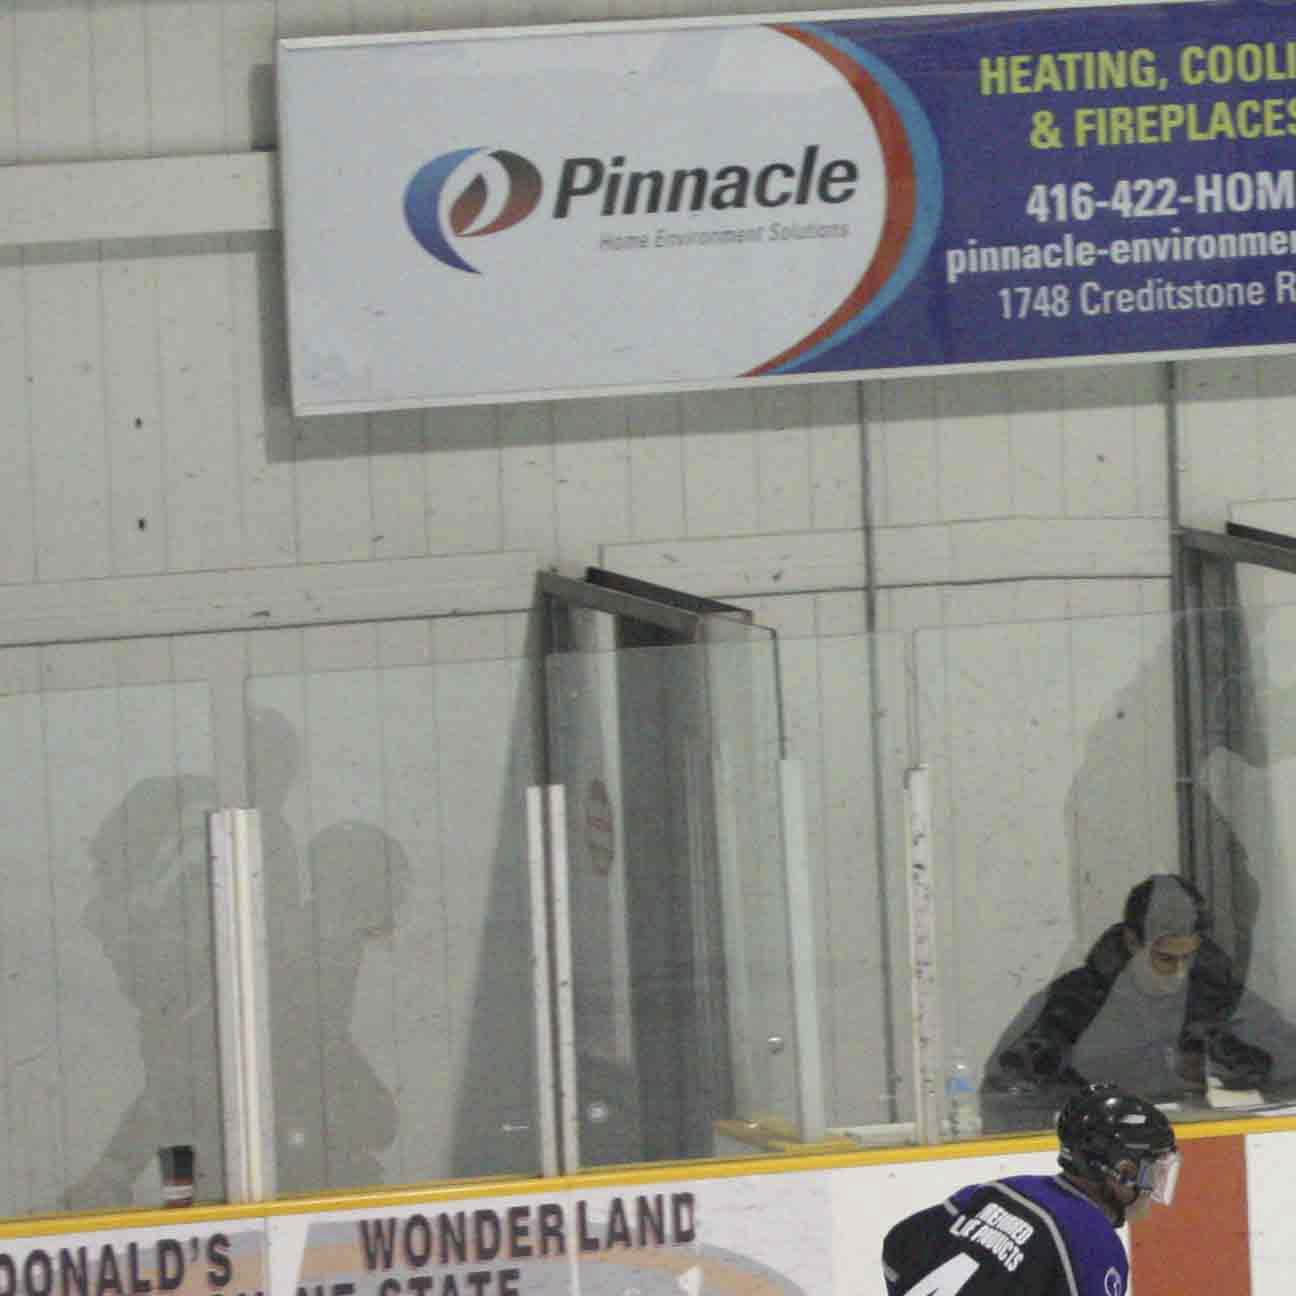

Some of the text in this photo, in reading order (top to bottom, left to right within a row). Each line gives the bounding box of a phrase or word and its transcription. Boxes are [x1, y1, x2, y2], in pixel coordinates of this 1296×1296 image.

[979, 48, 1169, 95] HEATING,
[1029, 109, 1062, 149] &
[552, 146, 859, 219] Pinnacle
[601, 221, 849, 250] Home Environment Solutions
[998, 286, 1071, 320] 1748
[1080, 275, 1267, 316] Creditstone
[359, 1192, 697, 1271] WONDERLAND
